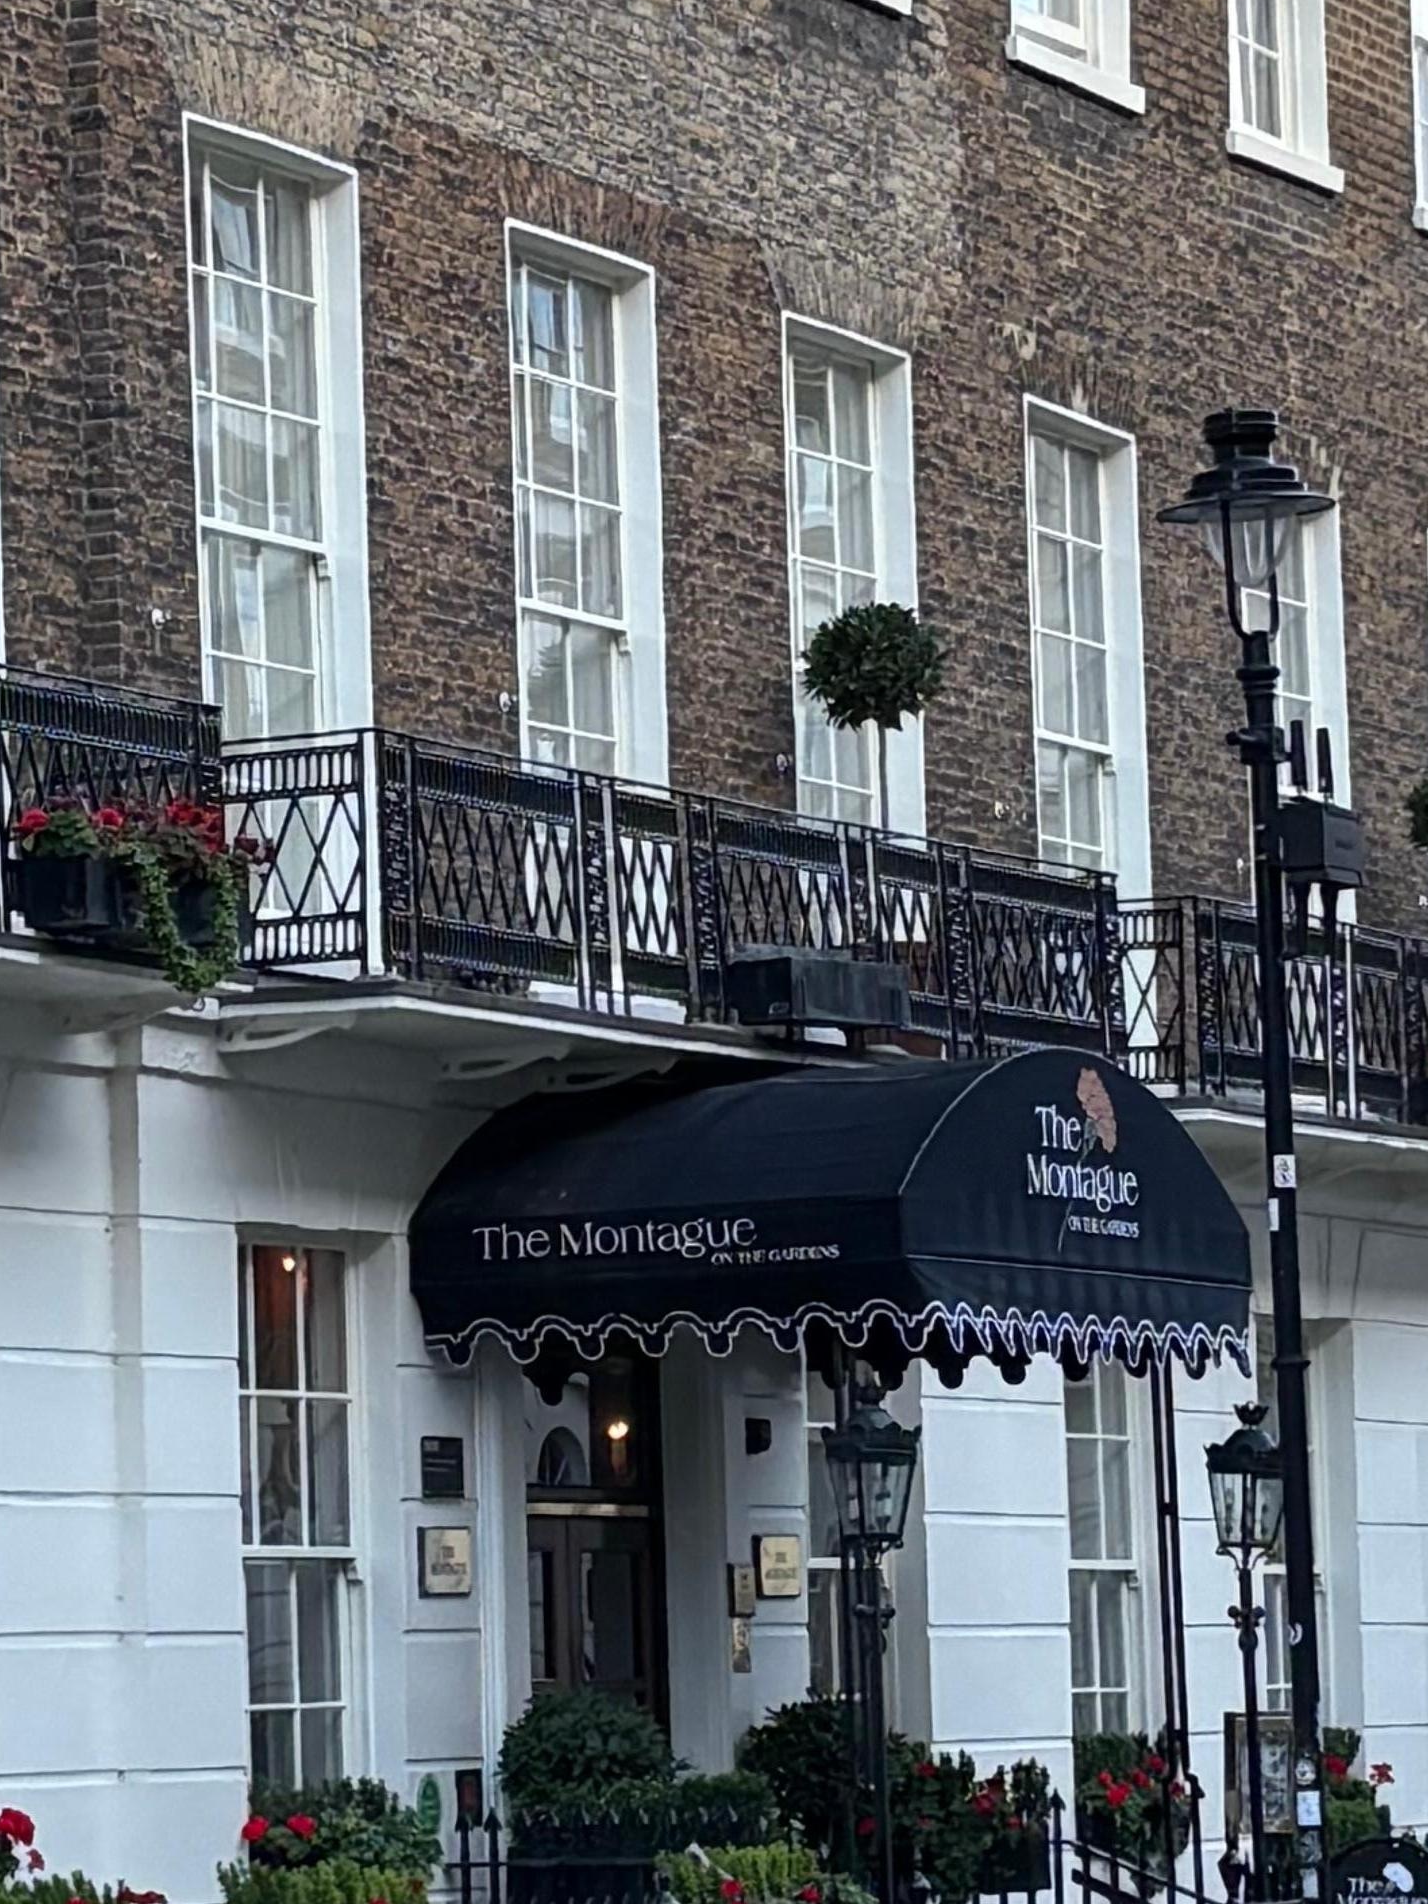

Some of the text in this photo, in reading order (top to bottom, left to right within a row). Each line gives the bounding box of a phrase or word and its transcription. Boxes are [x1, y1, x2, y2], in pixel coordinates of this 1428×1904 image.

[1034, 1104, 1082, 1152] The
[1027, 1153, 1140, 1213] Montague
[472, 1217, 758, 1260] The Montague
[1347, 1876, 1384, 1894] The
